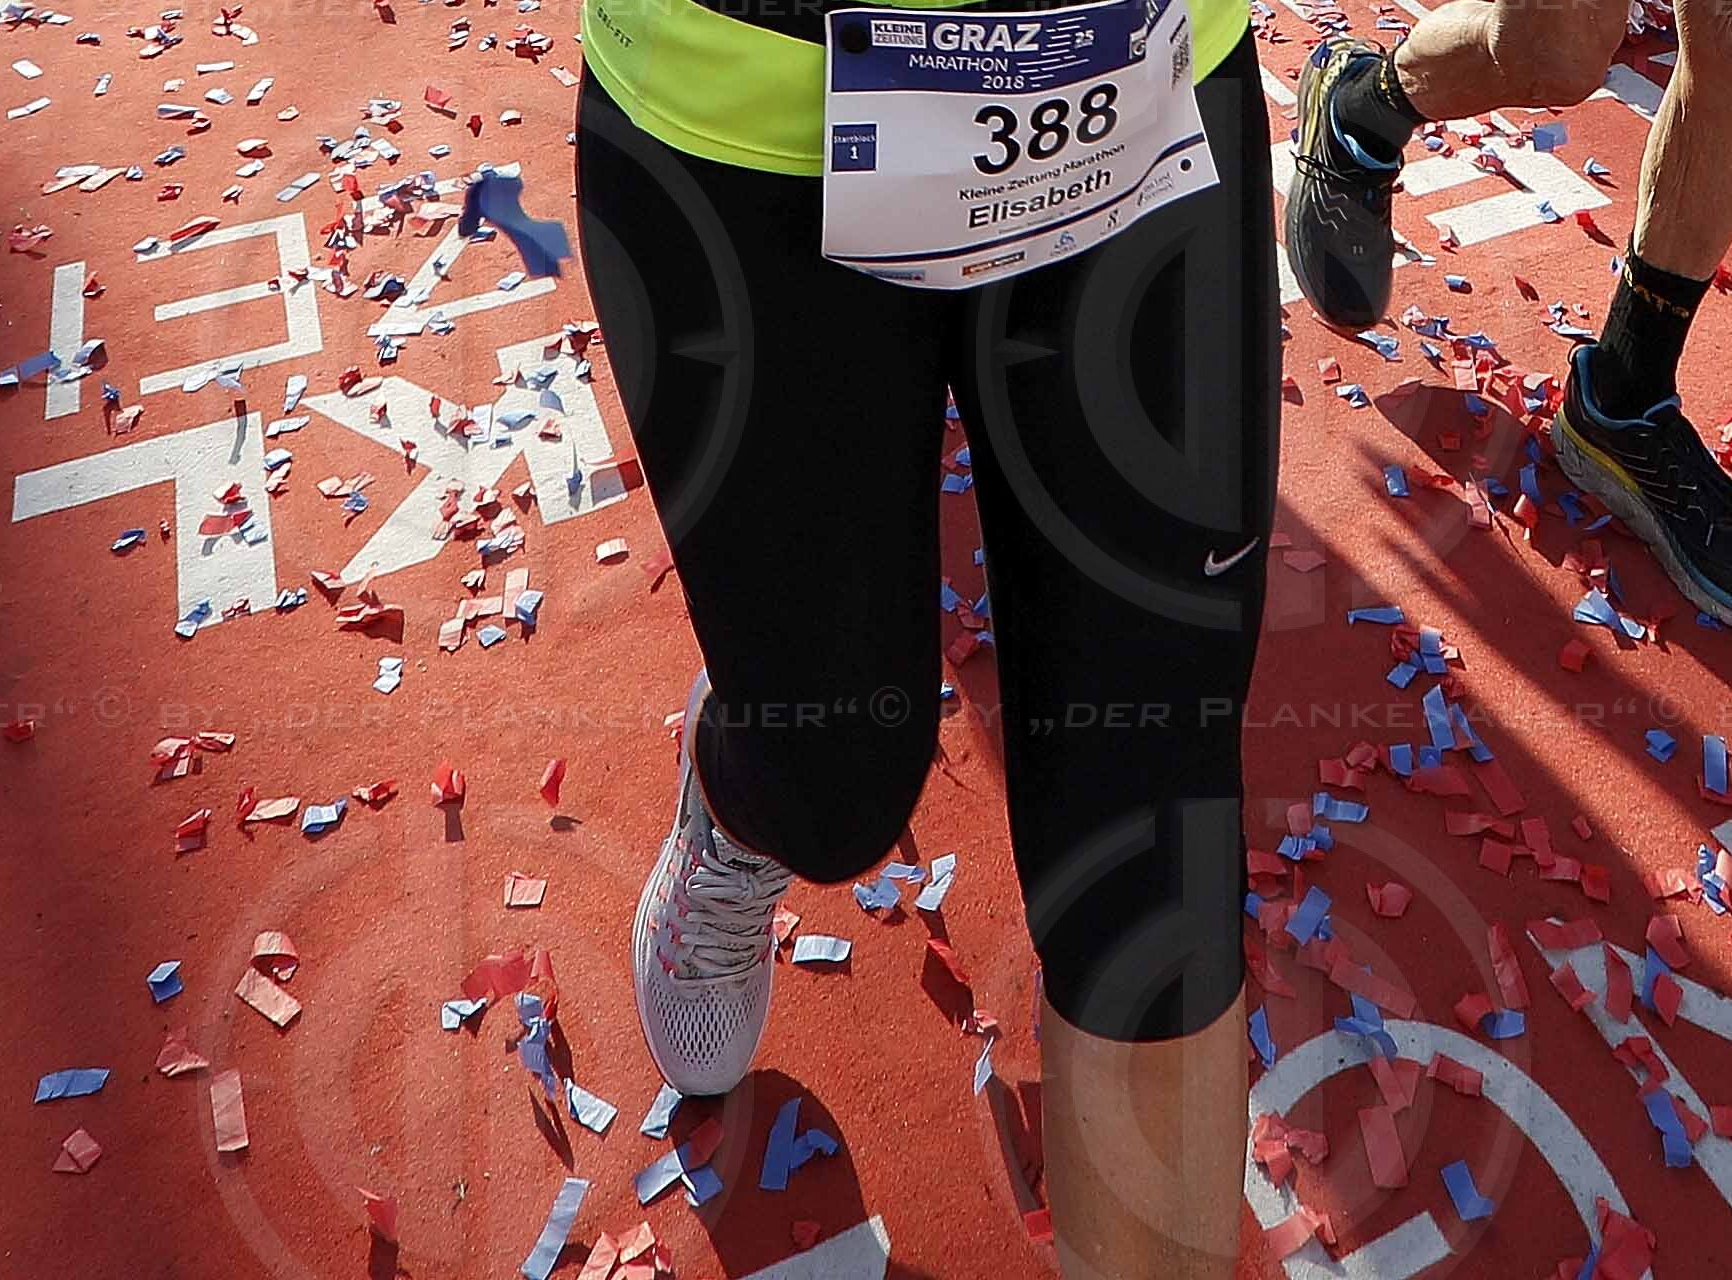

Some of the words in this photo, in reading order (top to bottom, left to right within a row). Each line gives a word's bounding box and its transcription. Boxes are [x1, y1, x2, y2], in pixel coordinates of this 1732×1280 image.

[873, 22, 924, 35] KLEINE
[932, 23, 1043, 53] GRAZ
[873, 34, 924, 46] ZEITUNG
[908, 54, 1009, 73] MARATHON
[982, 75, 1025, 90] 2018
[972, 83, 1119, 175] 388
[850, 145, 859, 160] 1
[958, 185, 1006, 201] Kleine
[1008, 168, 1061, 191] Zeitung
[1063, 143, 1126, 174] Marathon
[969, 169, 1113, 229] Elisabeth
